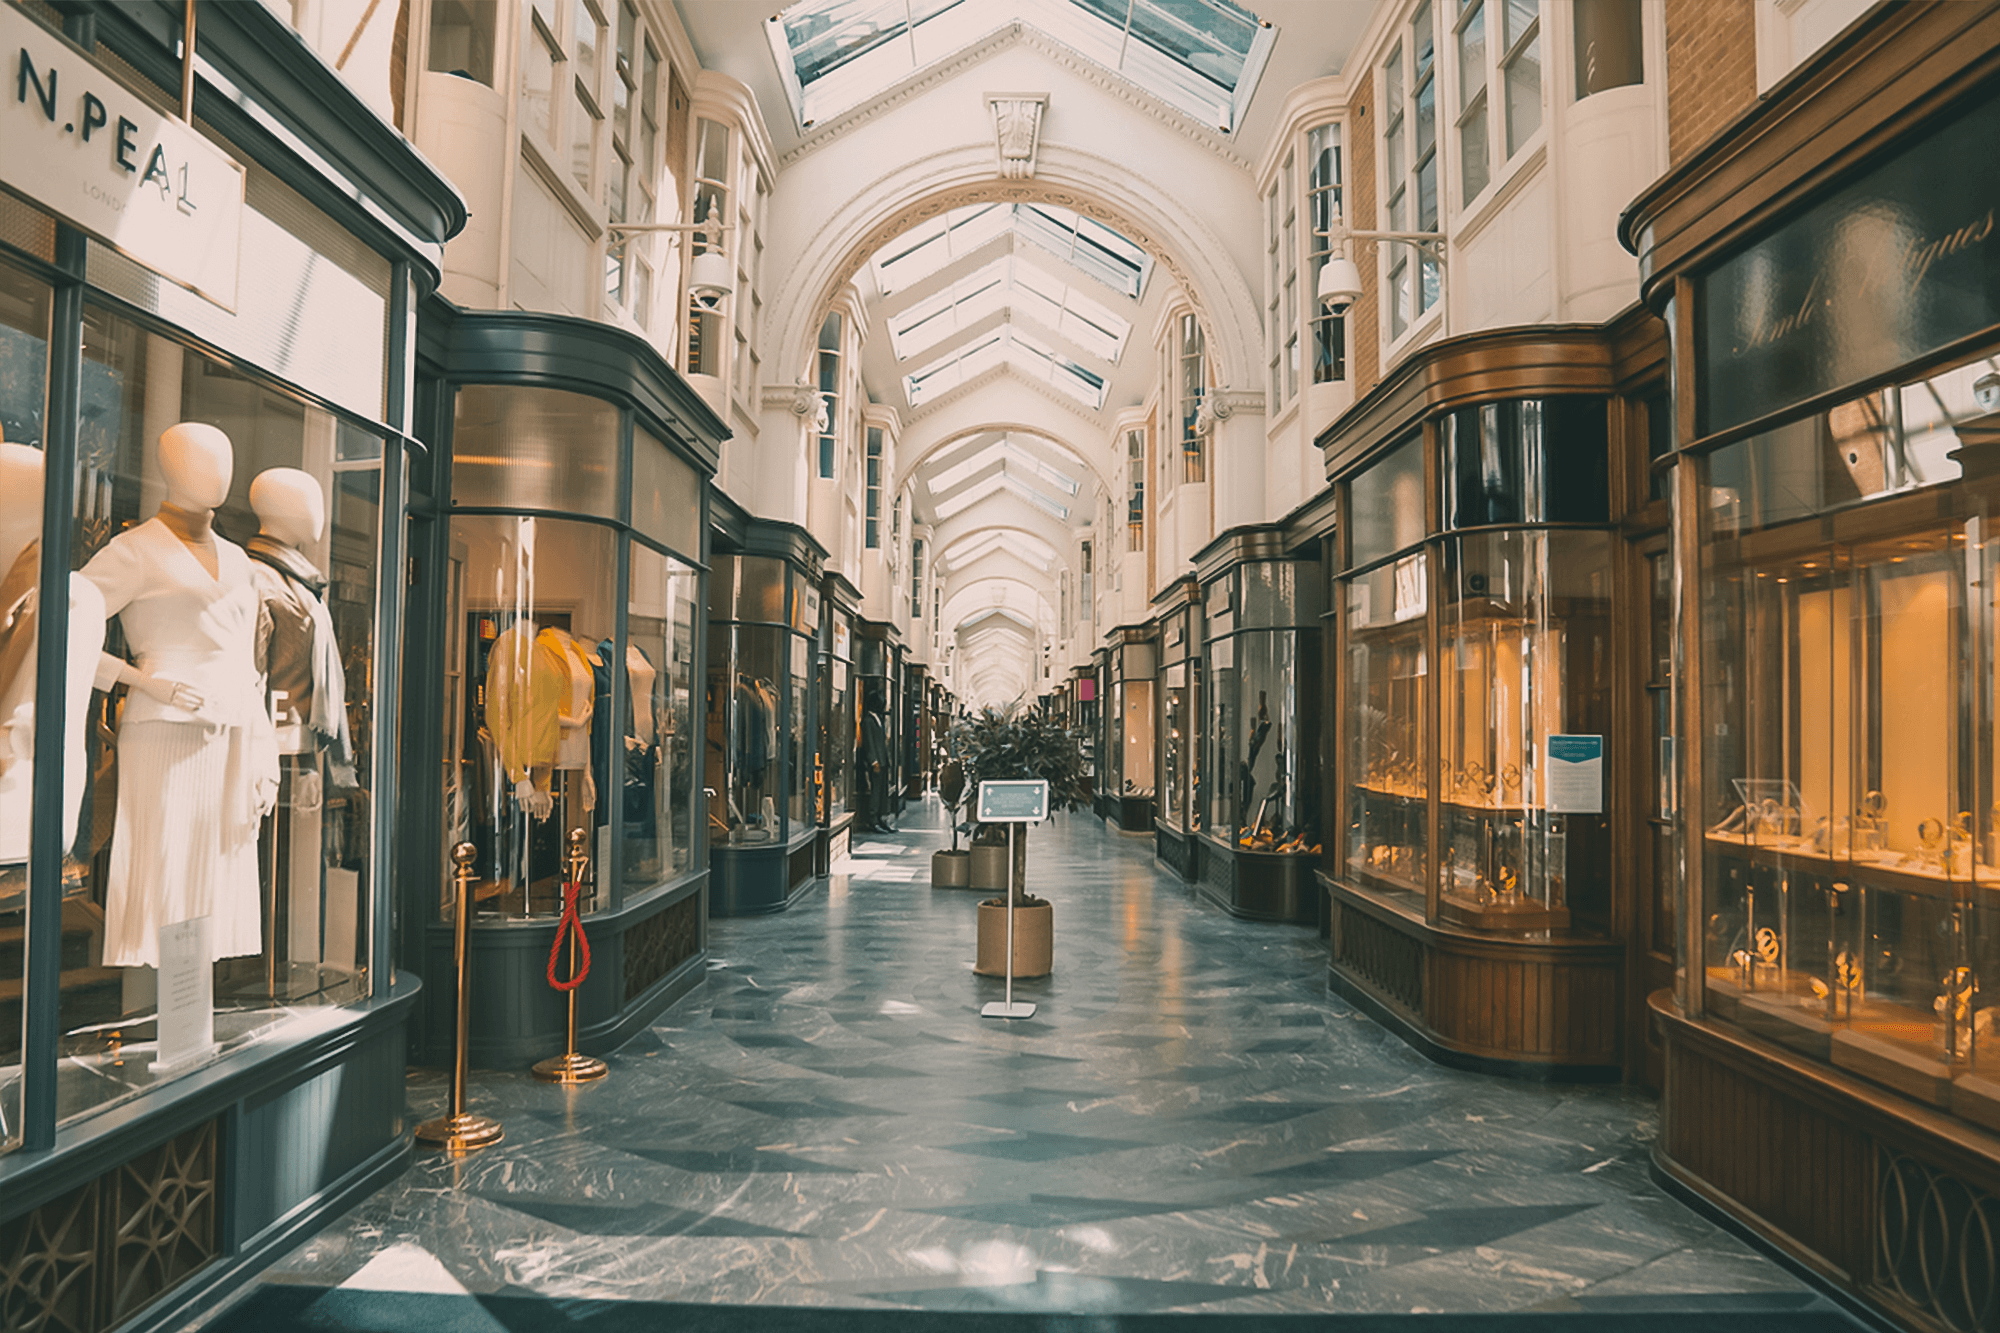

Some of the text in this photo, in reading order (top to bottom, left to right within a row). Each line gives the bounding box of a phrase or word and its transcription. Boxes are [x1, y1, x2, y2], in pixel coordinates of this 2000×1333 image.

[17, 47, 198, 212] N.PEAL
[82, 179, 128, 209] LOND
[1825, 208, 1996, 310] Atiques
